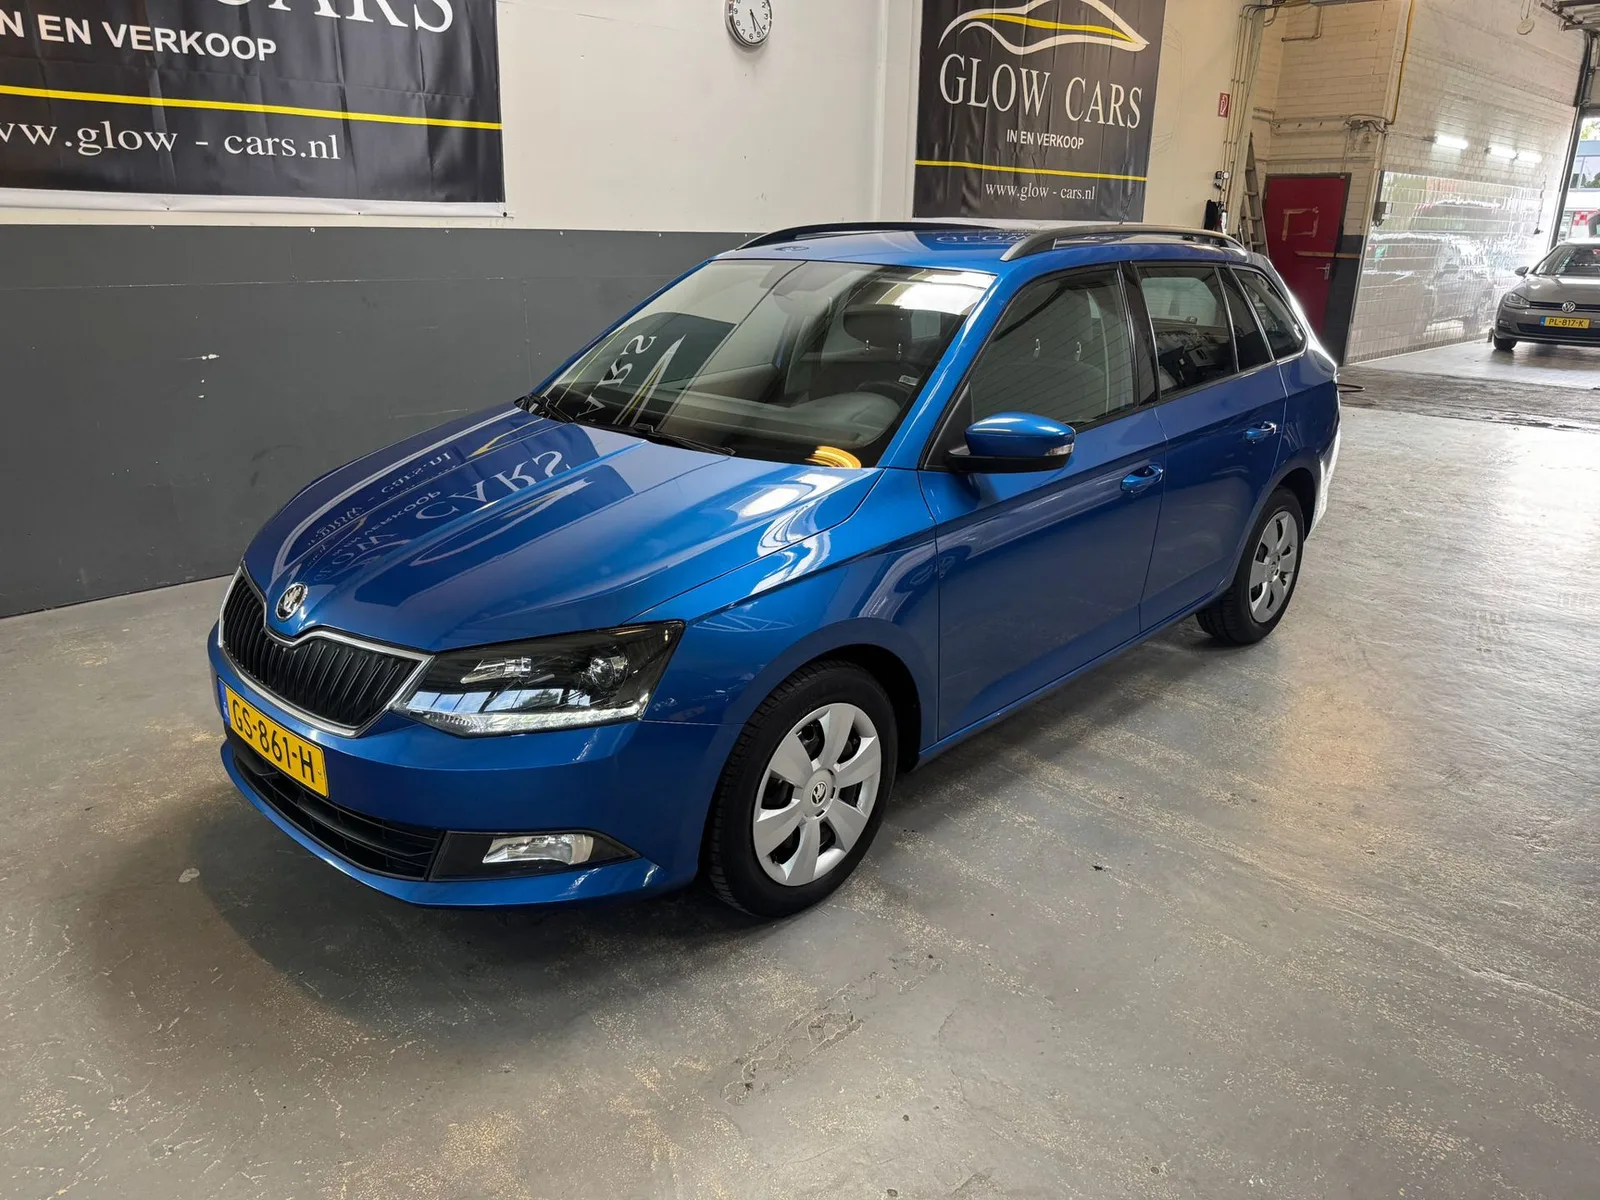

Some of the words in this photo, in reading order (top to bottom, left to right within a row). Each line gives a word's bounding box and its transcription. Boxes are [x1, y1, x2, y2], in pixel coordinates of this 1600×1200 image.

[37, 14, 92, 45] EN
[101, 21, 278, 62] VERKOOP
[939, 53, 1051, 117] GLOW
[1065, 77, 1143, 129] CARS
[223, 134, 341, 160] cars.nl
[1006, 129, 1018, 144] IN
[1020, 130, 1034, 146] EN
[1036, 132, 1085, 150] VERKOOP
[985, 182, 1050, 200] www.glow
[1060, 186, 1096, 200] cars.nl
[1548, 318, 1584, 327] PL-817-K
[232, 699, 316, 783] GS-861-H
